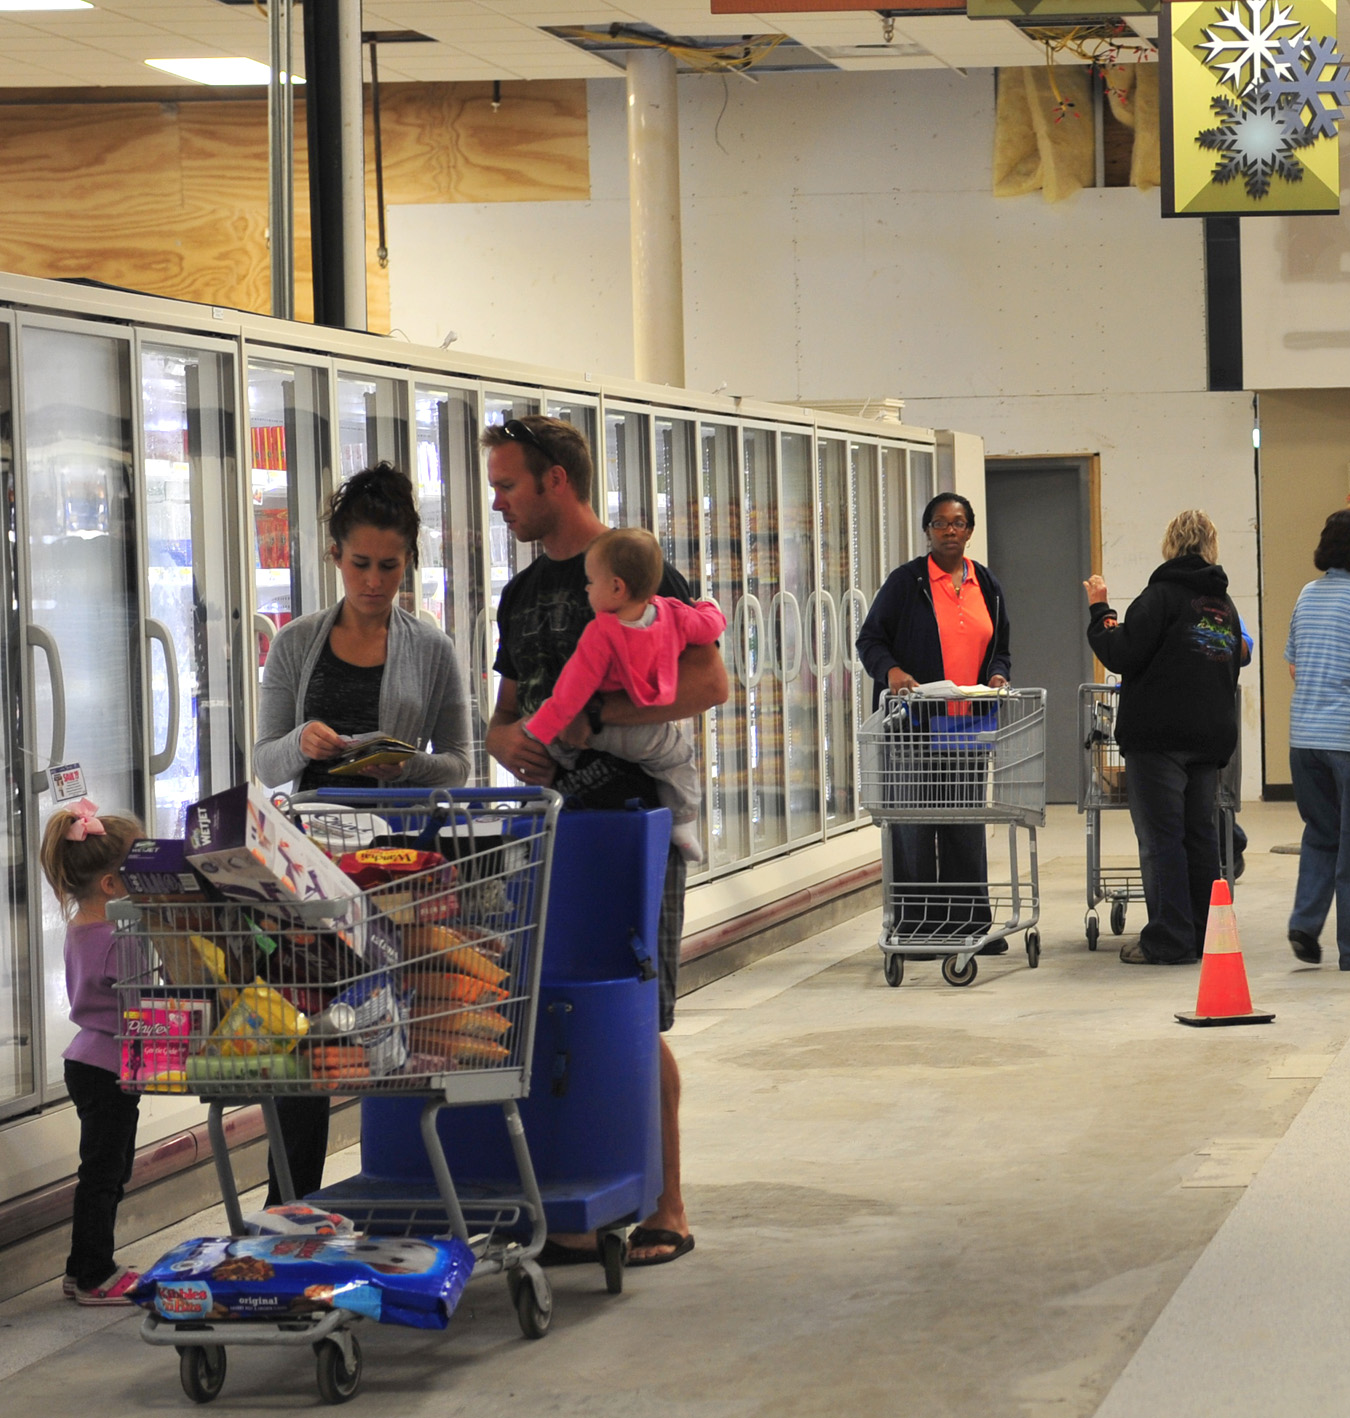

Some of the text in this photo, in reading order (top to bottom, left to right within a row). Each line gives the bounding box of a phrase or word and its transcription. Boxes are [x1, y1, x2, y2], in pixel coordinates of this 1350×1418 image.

[198, 806, 212, 847] WETJET
[125, 1020, 171, 1036] Playtex
[160, 1288, 208, 1302] Kibbles
[238, 1297, 278, 1307] original
